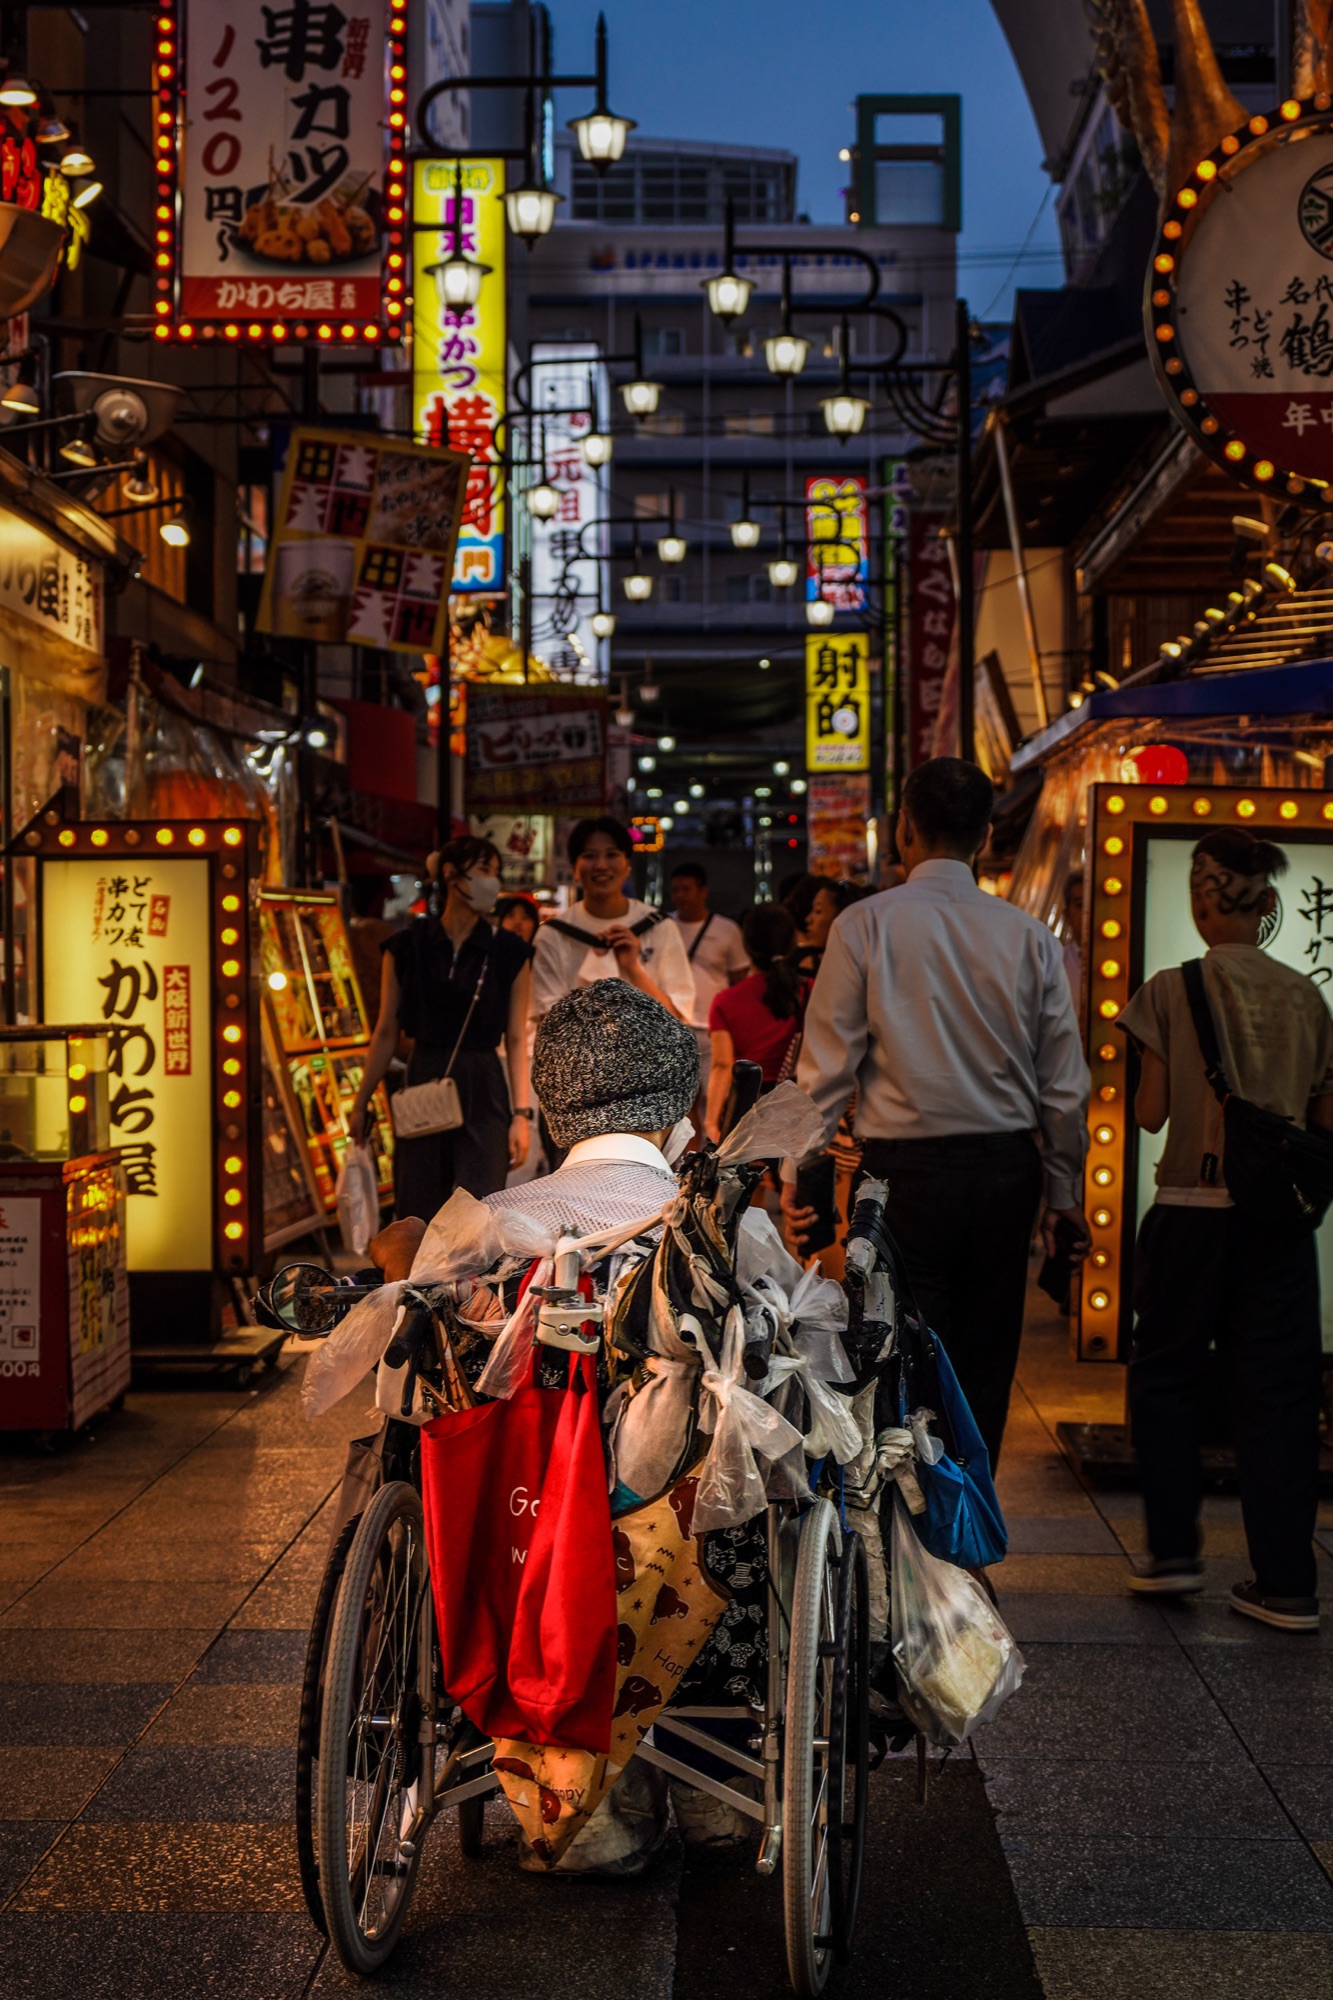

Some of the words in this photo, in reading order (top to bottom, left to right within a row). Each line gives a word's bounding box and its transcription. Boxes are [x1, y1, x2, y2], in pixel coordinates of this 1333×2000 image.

[341, 17, 370, 80] 新世界
[255, 3, 350, 204] 串カツ
[215, 281, 336, 310] かわち屋
[815, 643, 860, 740] 射的
[105, 876, 130, 946] 串カツ
[123, 876, 152, 948] どて煮
[165, 968, 188, 1071] 大阪新世界
[99, 958, 158, 1197] かわち屋
[0, 1361, 41, 1378] 00円
